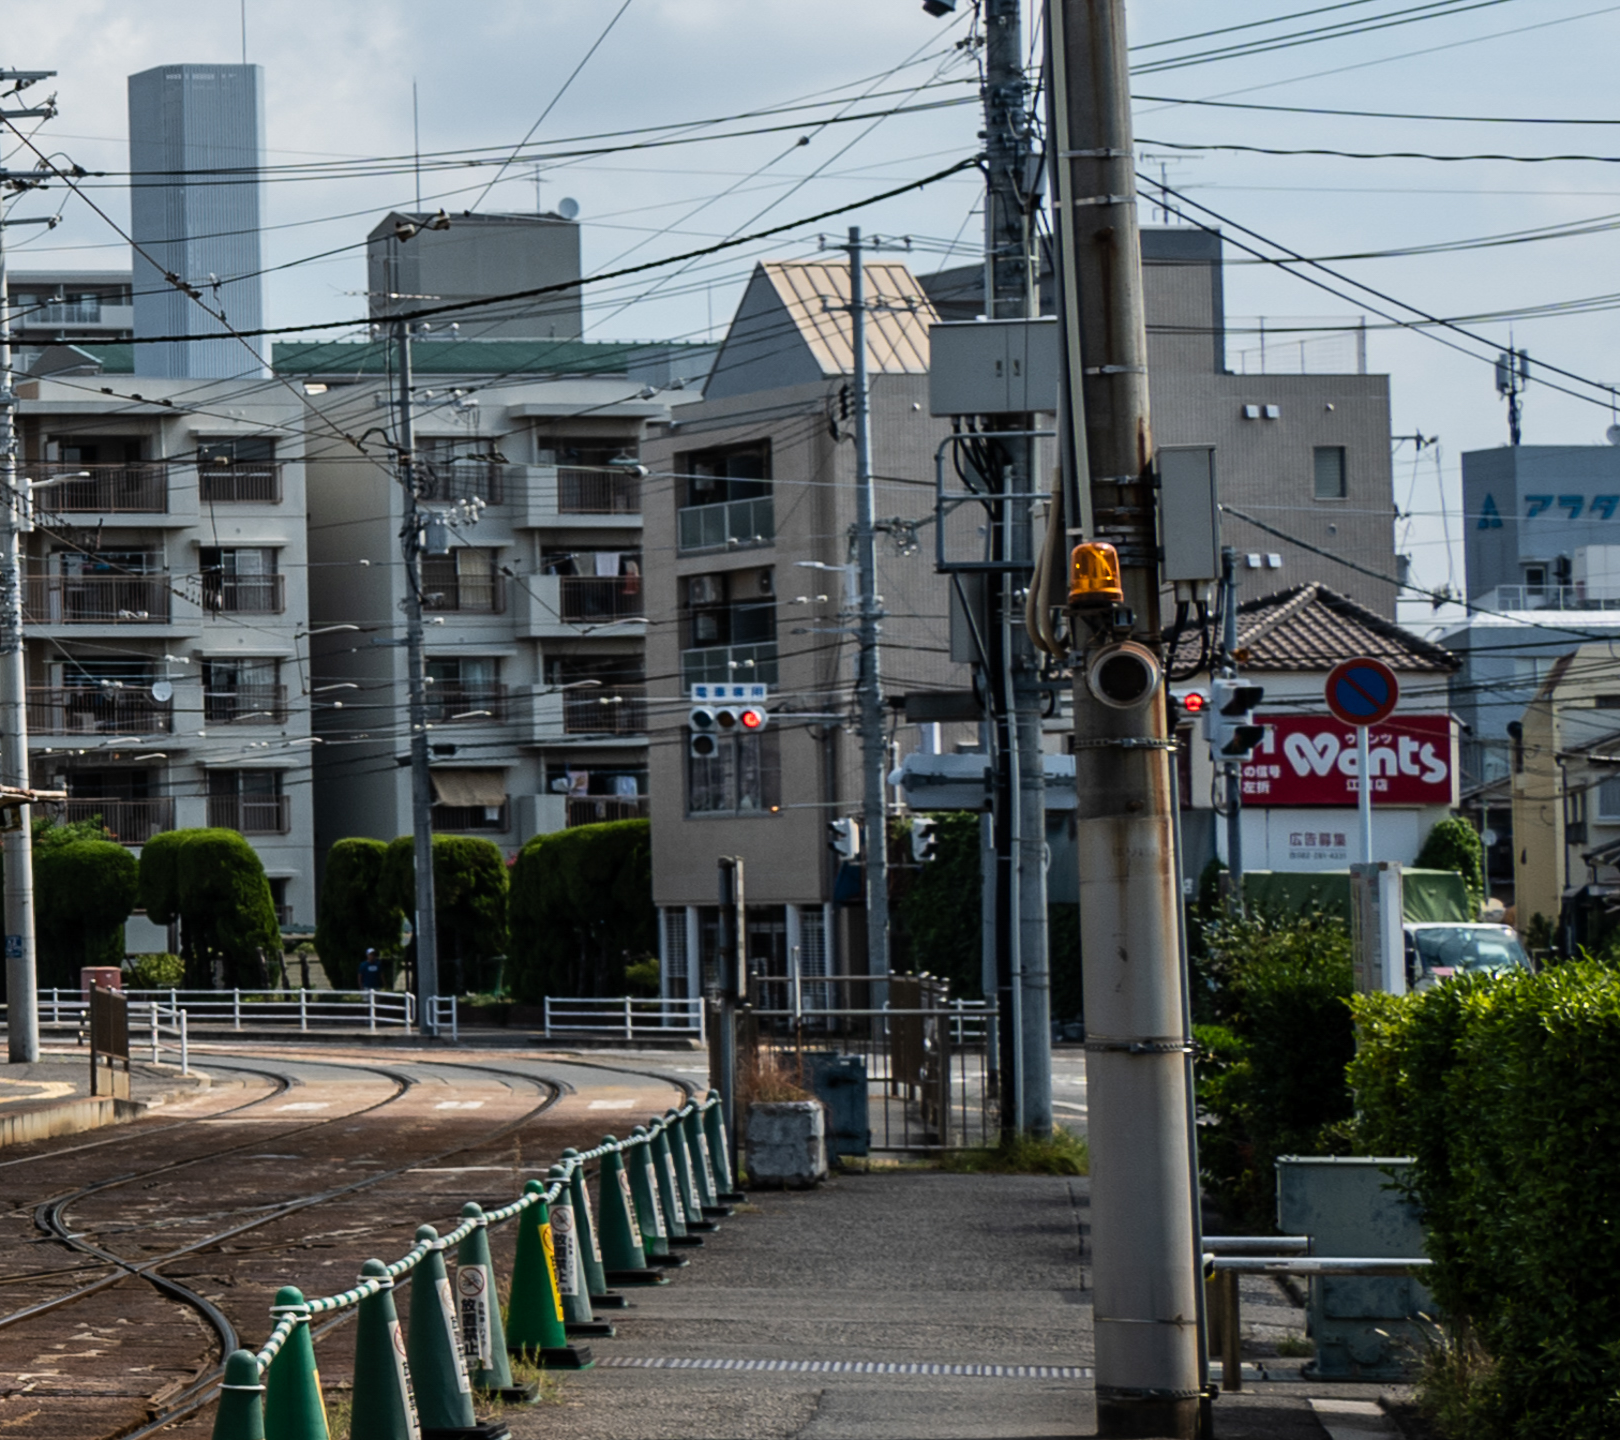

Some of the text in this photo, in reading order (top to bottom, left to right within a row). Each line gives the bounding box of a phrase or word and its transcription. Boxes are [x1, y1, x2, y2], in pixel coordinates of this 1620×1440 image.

[1283, 732, 1448, 784] Wants
[1345, 733, 1392, 745] ウンツ
[461, 1298, 479, 1356] 放置禁止
